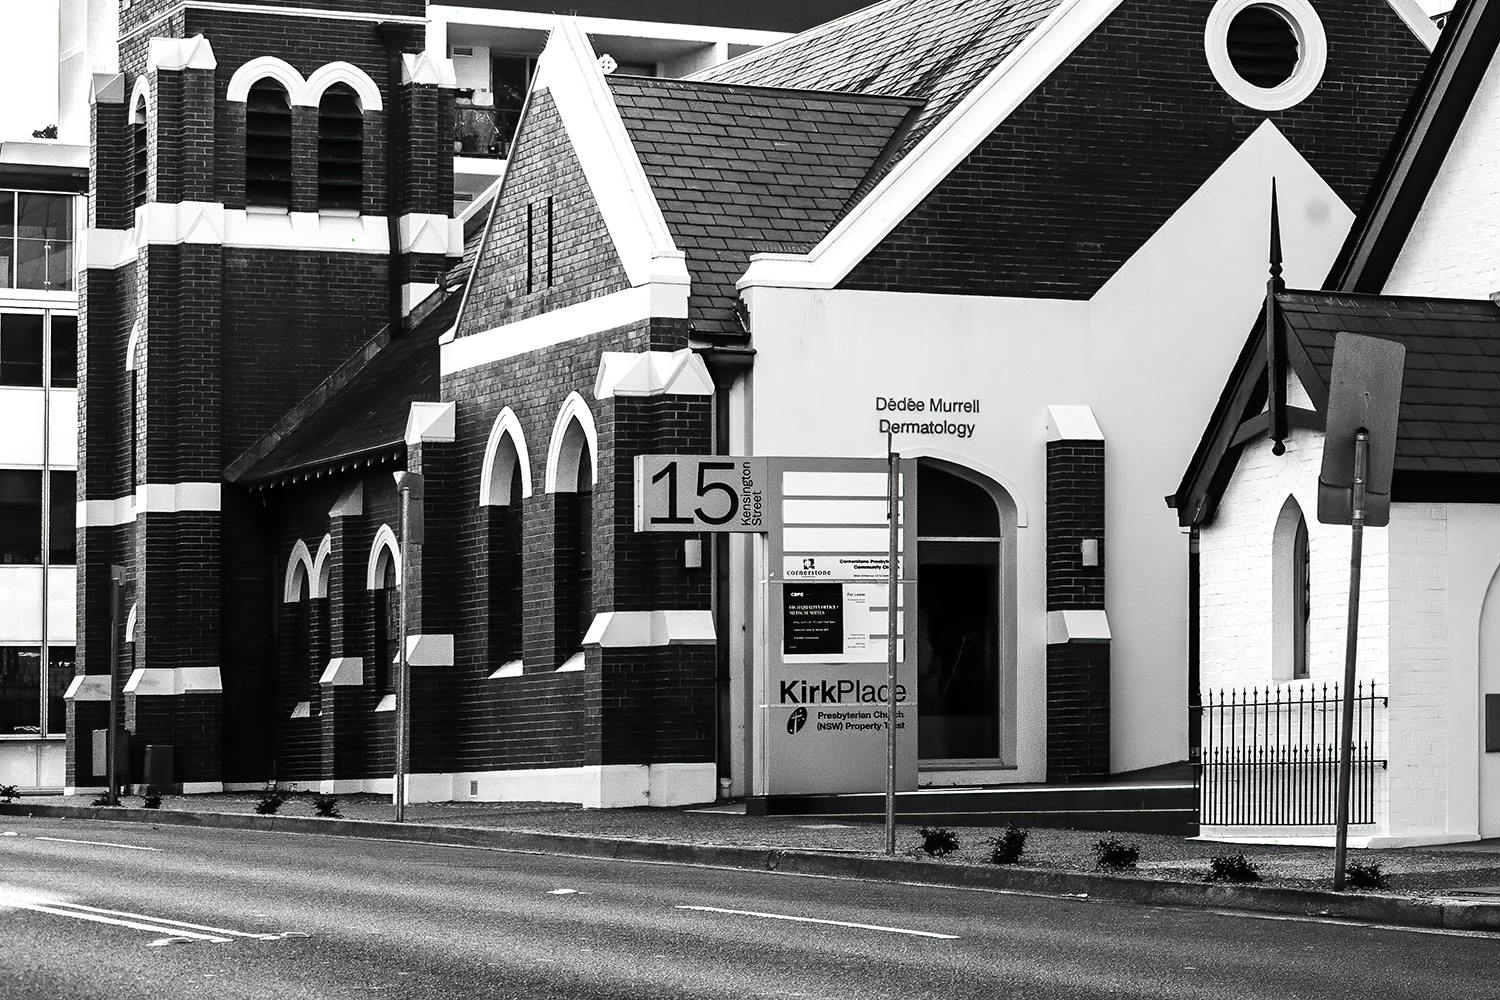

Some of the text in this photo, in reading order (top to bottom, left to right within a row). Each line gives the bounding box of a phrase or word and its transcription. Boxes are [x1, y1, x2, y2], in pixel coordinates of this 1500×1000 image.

[875, 396, 980, 413] Dédée Murrell
[879, 418, 976, 439] Dermatology
[650, 461, 740, 526] 15
[740, 461, 753, 526] Kensington
[751, 490, 762, 527] Street
[780, 679, 907, 704] KirkPlace
[816, 721, 844, 732] (NSW)
[845, 722, 882, 731] Property
[817, 711, 872, 721] Presbyterian
